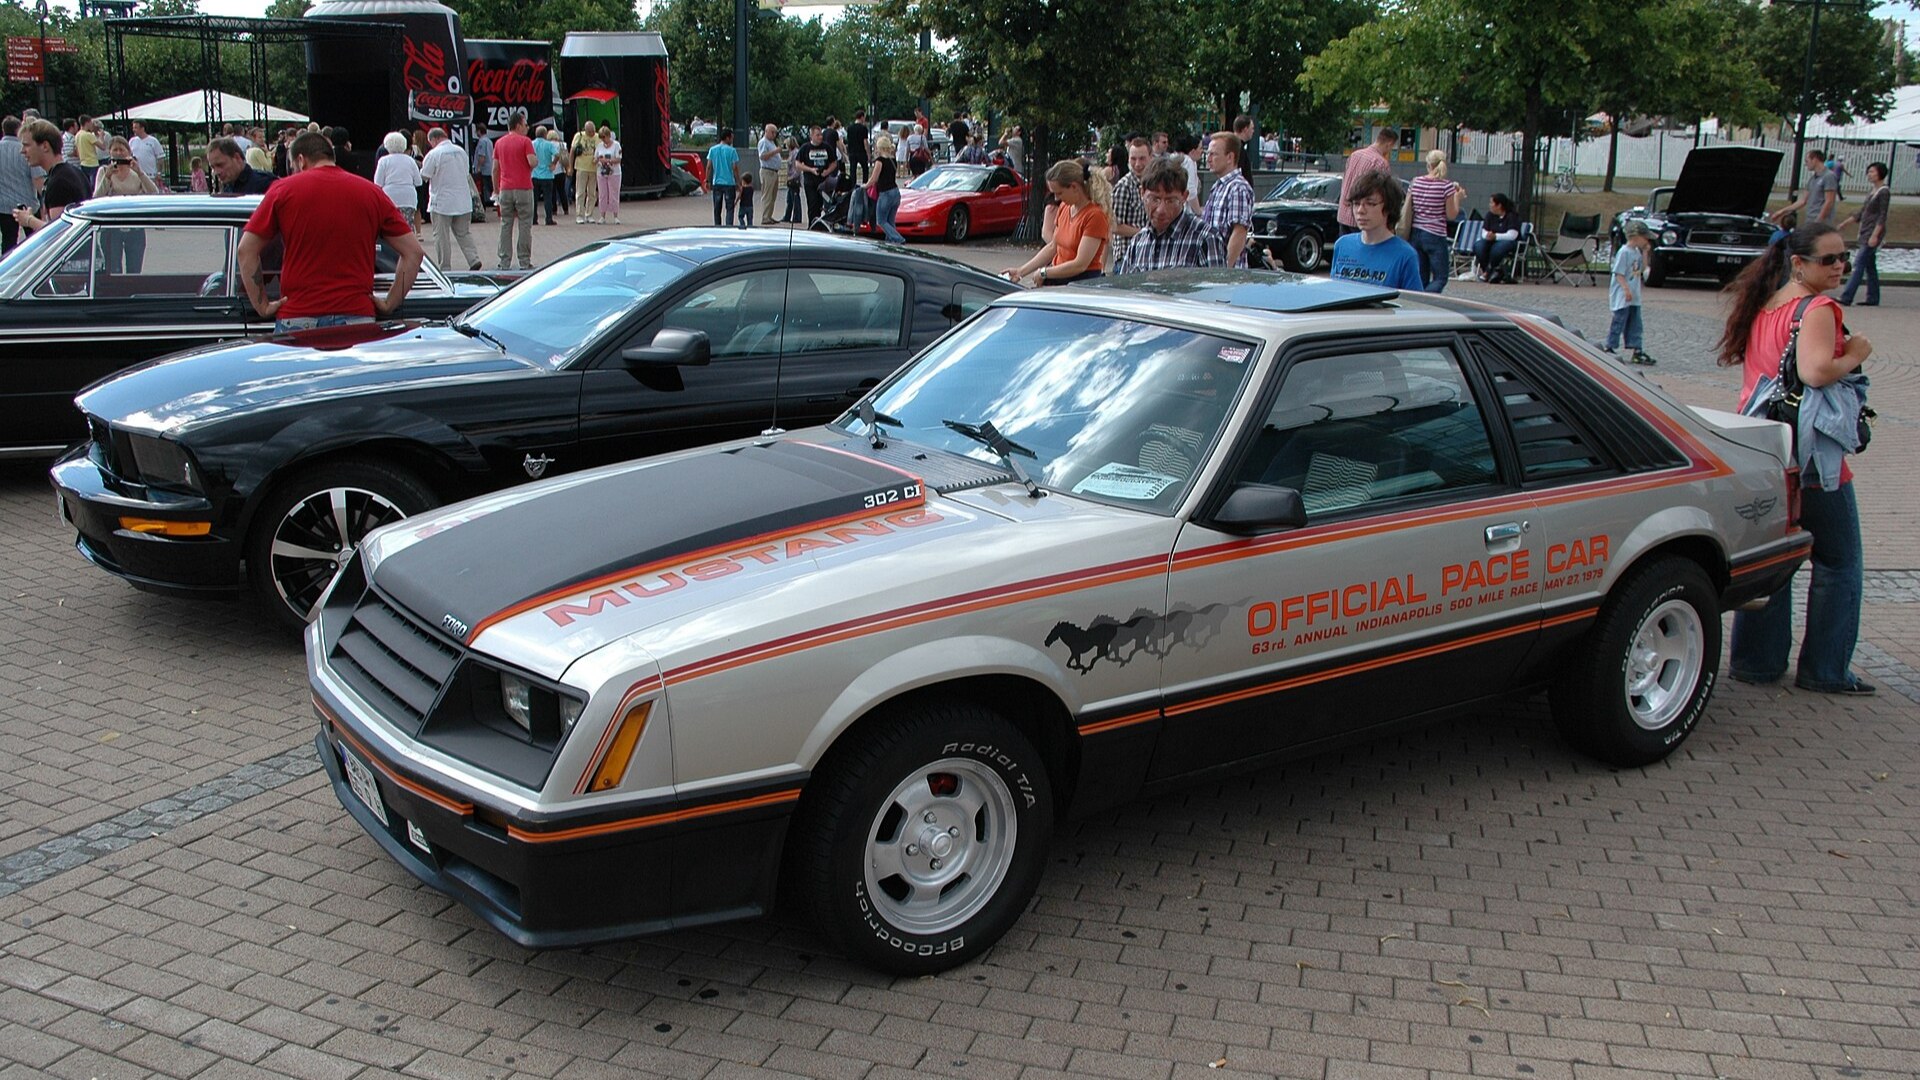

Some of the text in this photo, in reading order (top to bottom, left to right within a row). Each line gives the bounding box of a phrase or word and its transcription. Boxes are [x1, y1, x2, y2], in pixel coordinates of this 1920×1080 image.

[415, 92, 468, 111] Coca-Cola
[467, 57, 548, 103] Coca-Cola
[428, 108, 455, 119] zero
[863, 484, 922, 509] 302 CI
[542, 509, 945, 628] MUSTANG
[1248, 534, 1610, 637] OFFICIAL PACE CAR
[442, 613, 468, 638] FORD
[1294, 625, 1348, 646] ANNUAL
[1356, 603, 1443, 632] INDIANAPOLIS
[1450, 597, 1473, 612] 500
[1478, 589, 1505, 605] MILE
[1510, 582, 1538, 597] RACE
[1544, 576, 1567, 591] MAY
[1582, 568, 1604, 582] 1979
[941, 742, 1036, 809] Radial T/A
[855, 880, 965, 956] BFGoodrich
